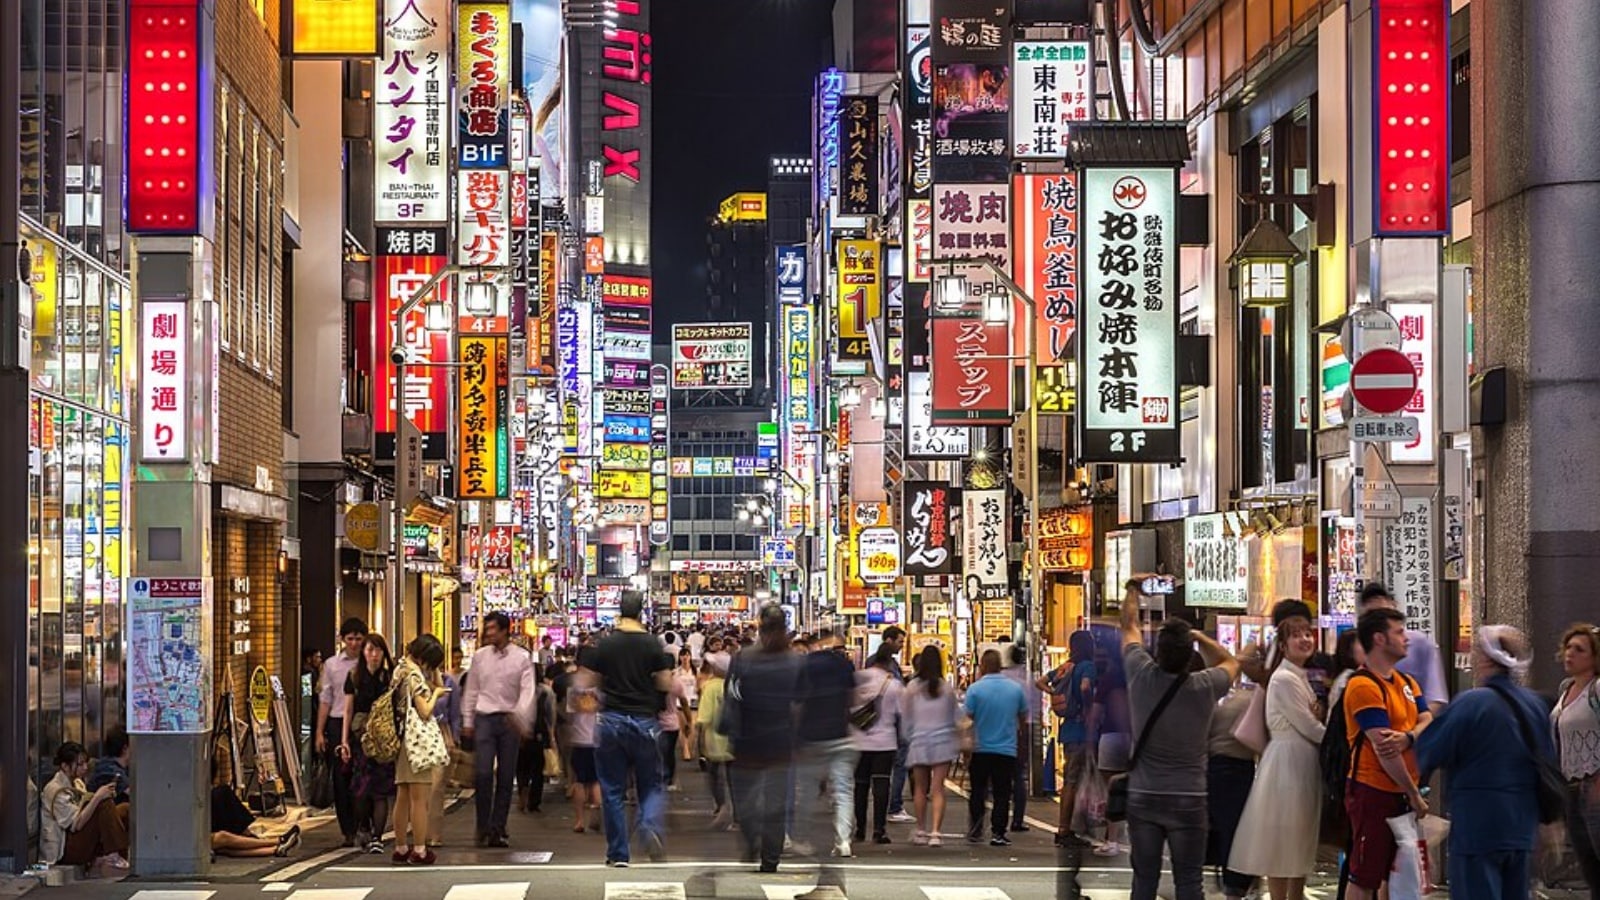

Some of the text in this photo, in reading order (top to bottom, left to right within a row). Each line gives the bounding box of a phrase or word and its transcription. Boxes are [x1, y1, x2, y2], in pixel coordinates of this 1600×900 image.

[471, 11, 499, 135] まぐろ商店
[1017, 45, 1086, 61] 全卓全自動
[384, 50, 419, 175] バンタイ
[425, 51, 440, 166] タイ国料理専門店
[1033, 64, 1057, 155] 東南荘
[463, 144, 504, 161] B1F
[382, 191, 440, 200] RESTAURANT
[397, 204, 425, 218] 3F
[388, 231, 436, 254] 焼肉
[1042, 177, 1076, 361] 焼鳥釜めし
[471, 319, 496, 332] 4F
[844, 287, 867, 334] 1
[1098, 210, 1139, 414] お好み焼本陣
[151, 313, 177, 447] 劇場通り
[955, 322, 991, 407] ステップ
[1110, 431, 1146, 452] 2F
[1354, 422, 1413, 438] 自転車を除く
[1402, 511, 1419, 631] 防犯カメラ作動中
